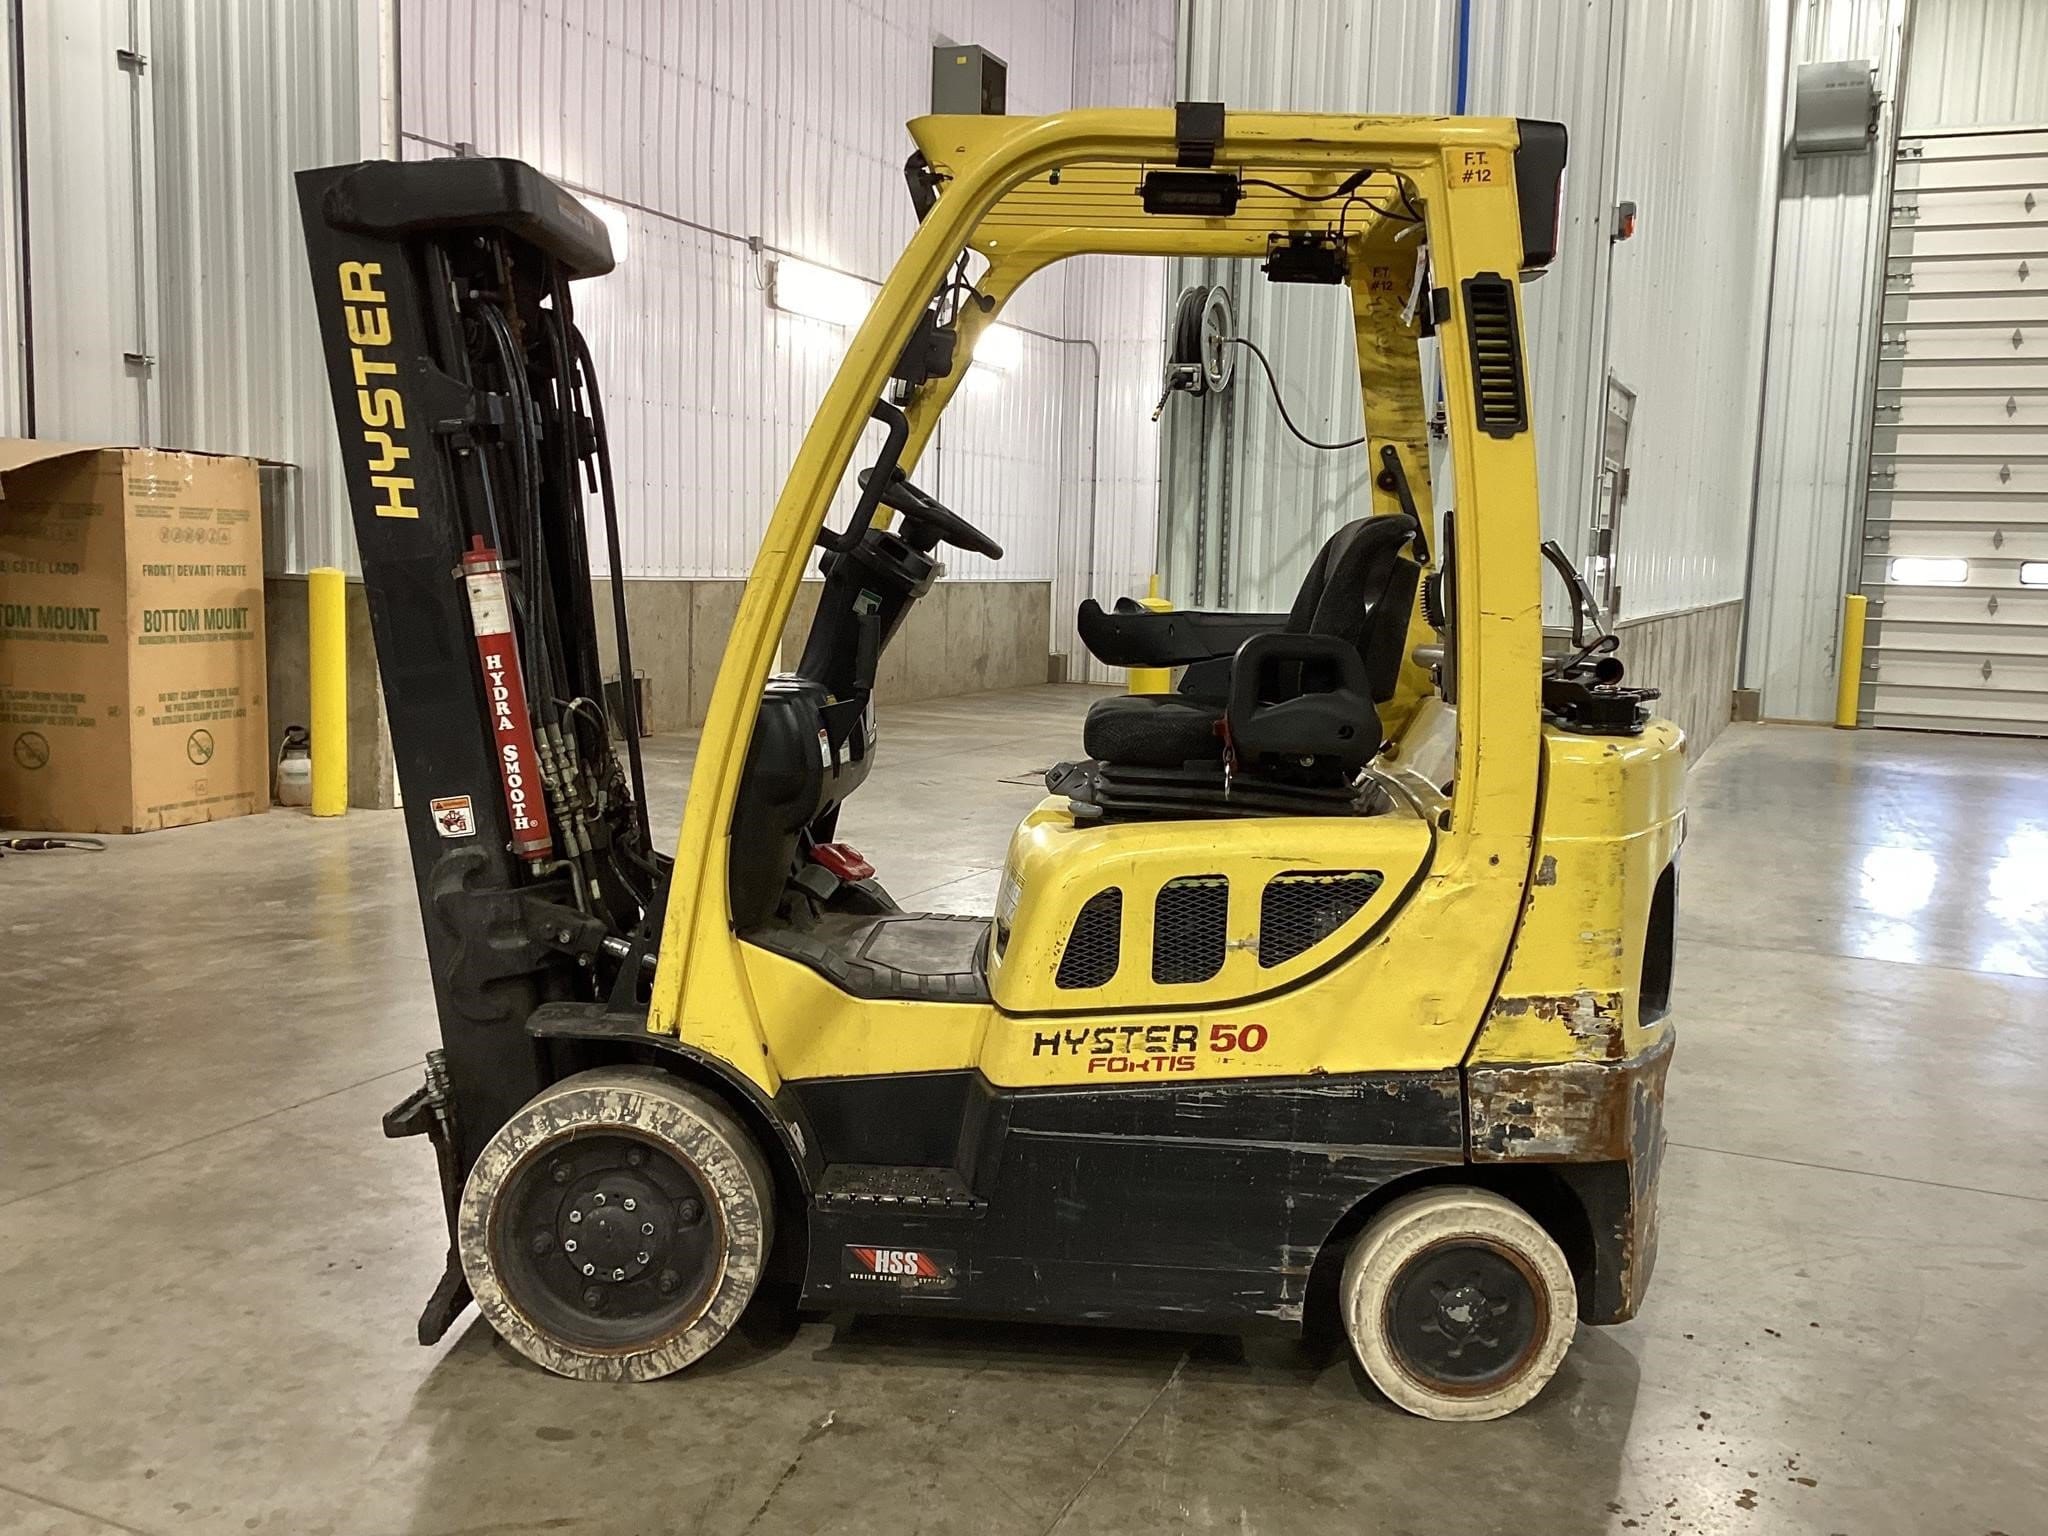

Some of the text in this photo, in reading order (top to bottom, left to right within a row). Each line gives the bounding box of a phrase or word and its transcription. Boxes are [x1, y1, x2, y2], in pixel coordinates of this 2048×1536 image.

[1464, 151, 1488, 166] F.T.
[1462, 169, 1491, 183] #12
[338, 260, 420, 519] HYSTER
[37, 605, 100, 631] MOUNT
[143, 607, 249, 632] BOTTOM MOUNT
[485, 654, 515, 731] HYDRA
[1032, 1023, 1268, 1056] HYSTER 50
[874, 1249, 919, 1275] HSS
